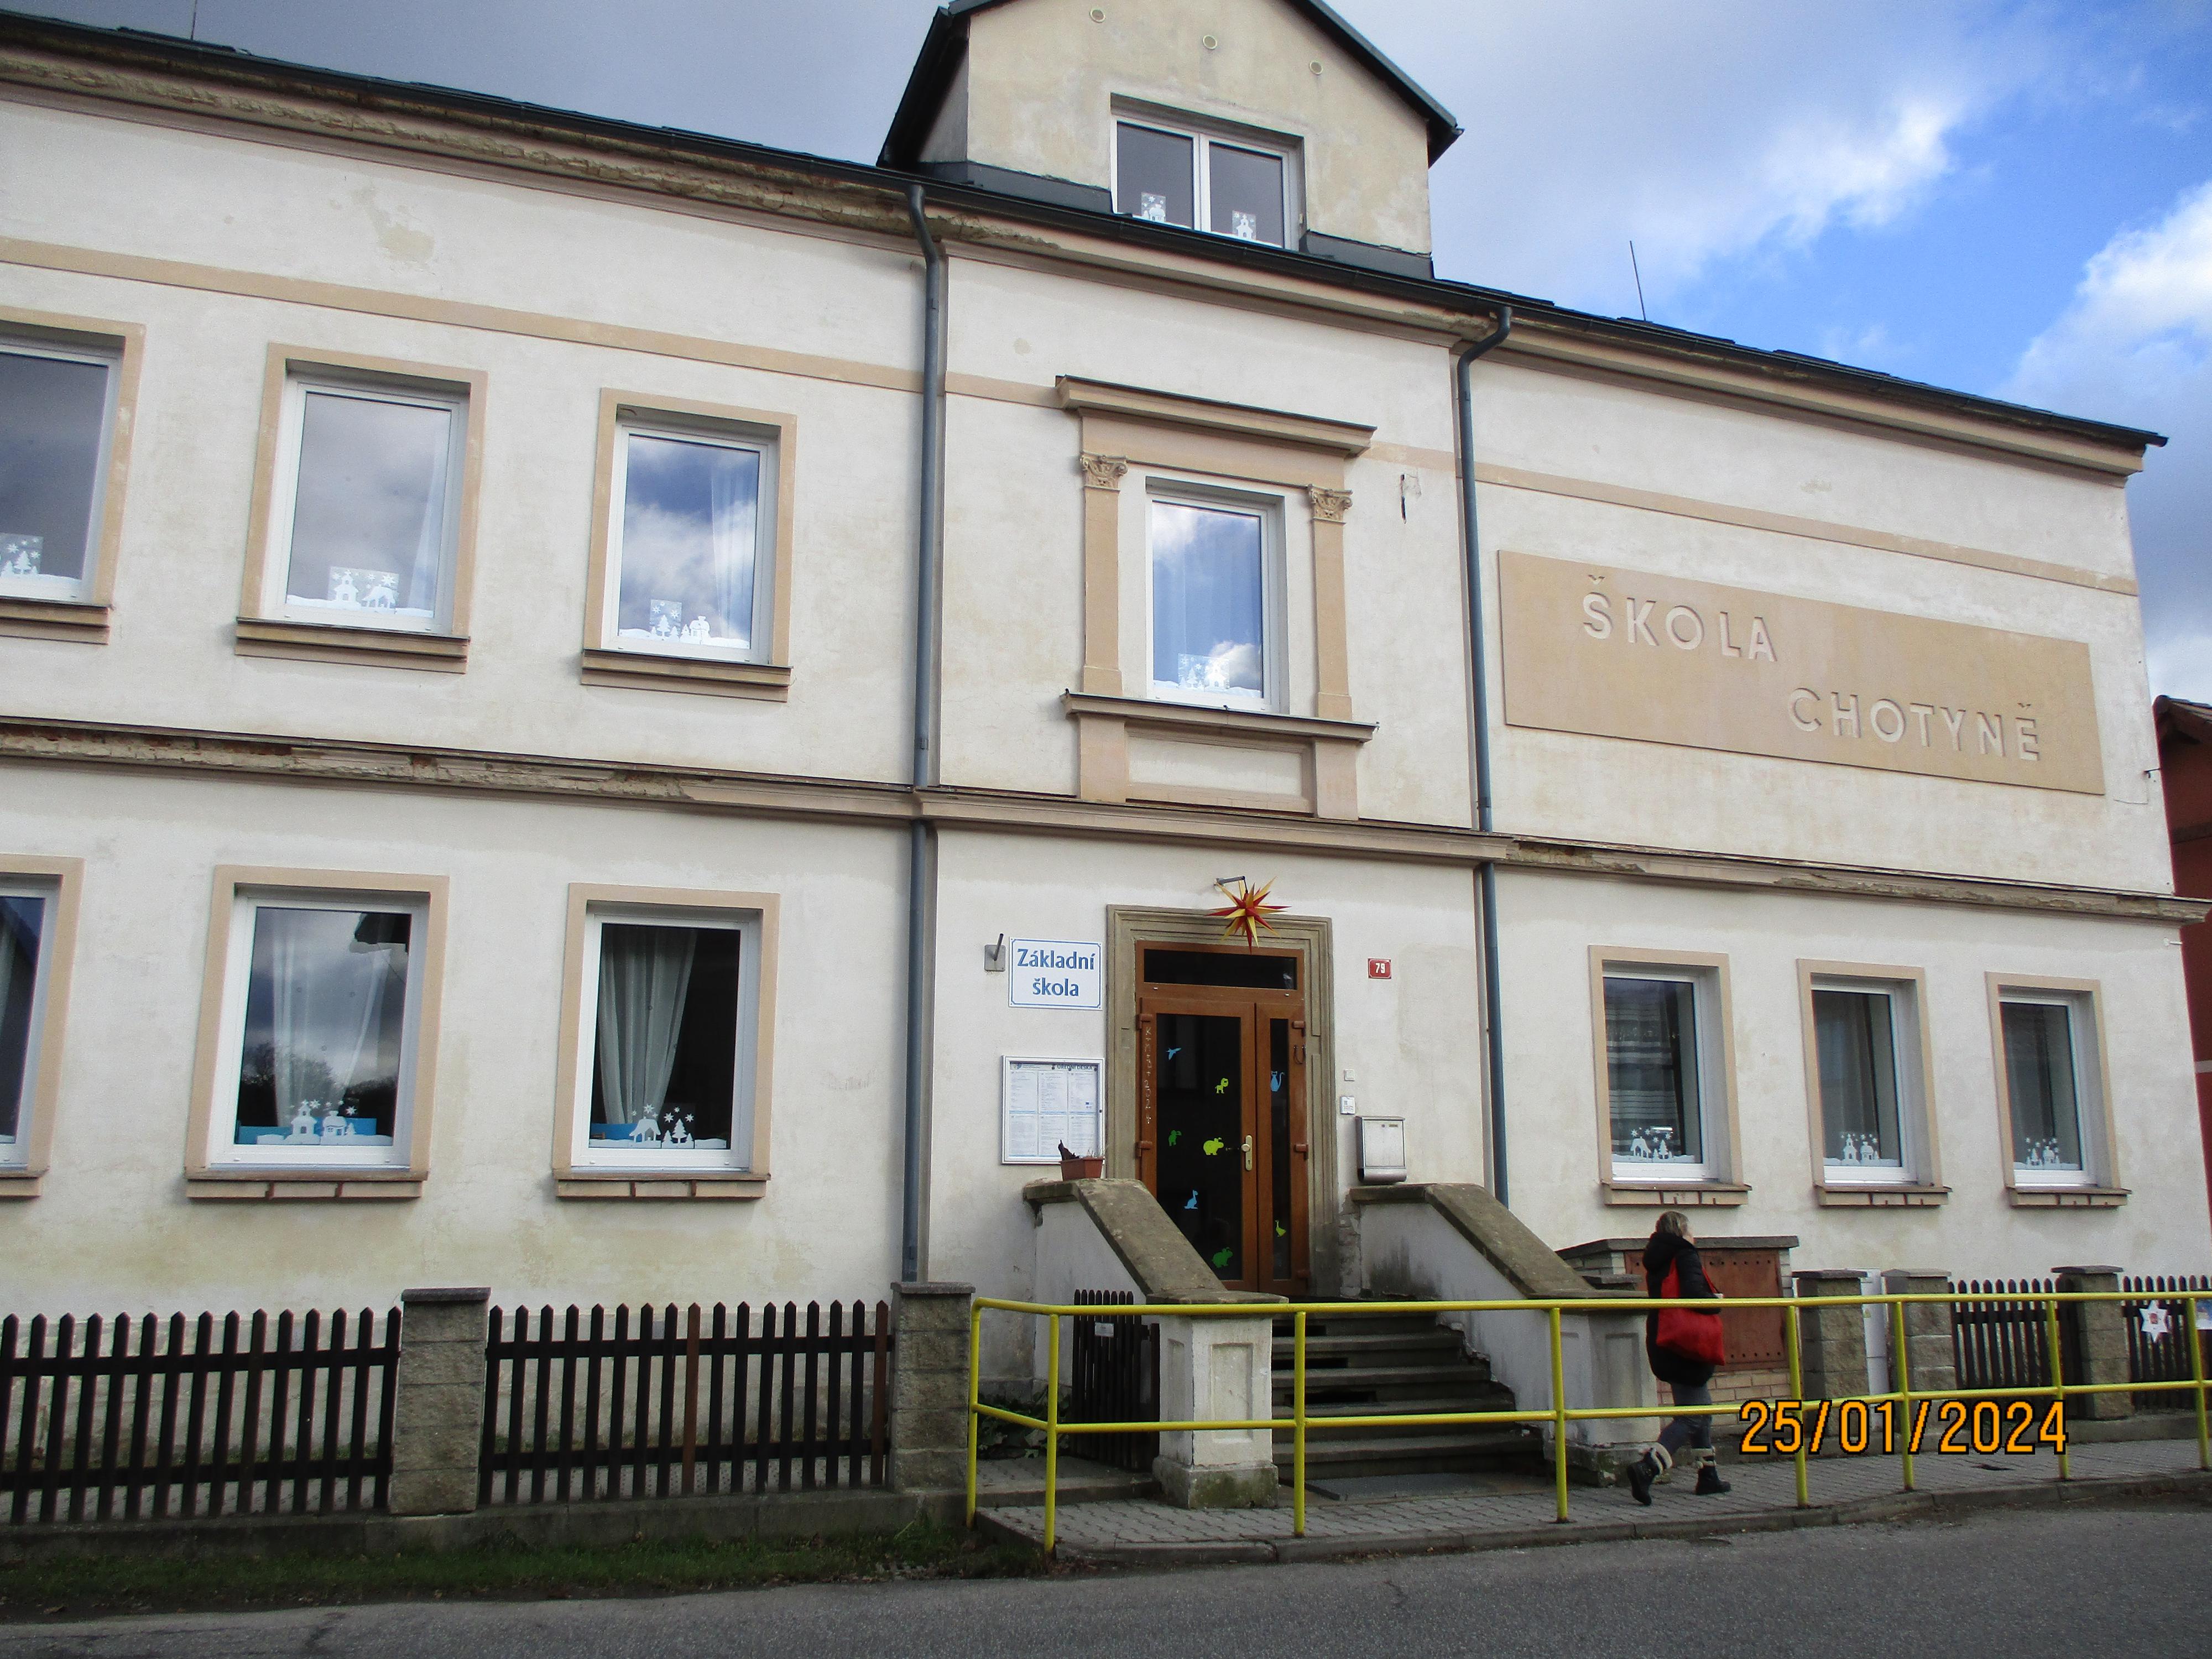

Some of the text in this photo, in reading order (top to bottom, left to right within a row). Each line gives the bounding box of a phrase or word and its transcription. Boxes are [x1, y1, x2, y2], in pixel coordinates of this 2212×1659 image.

[1583, 574, 1777, 662] ŠKOLA
[1788, 687, 2040, 761] CHOTYNĚ
[1018, 948, 1095, 969] Základní
[1375, 963, 1385, 973] 79
[1032, 977, 1079, 997] škola
